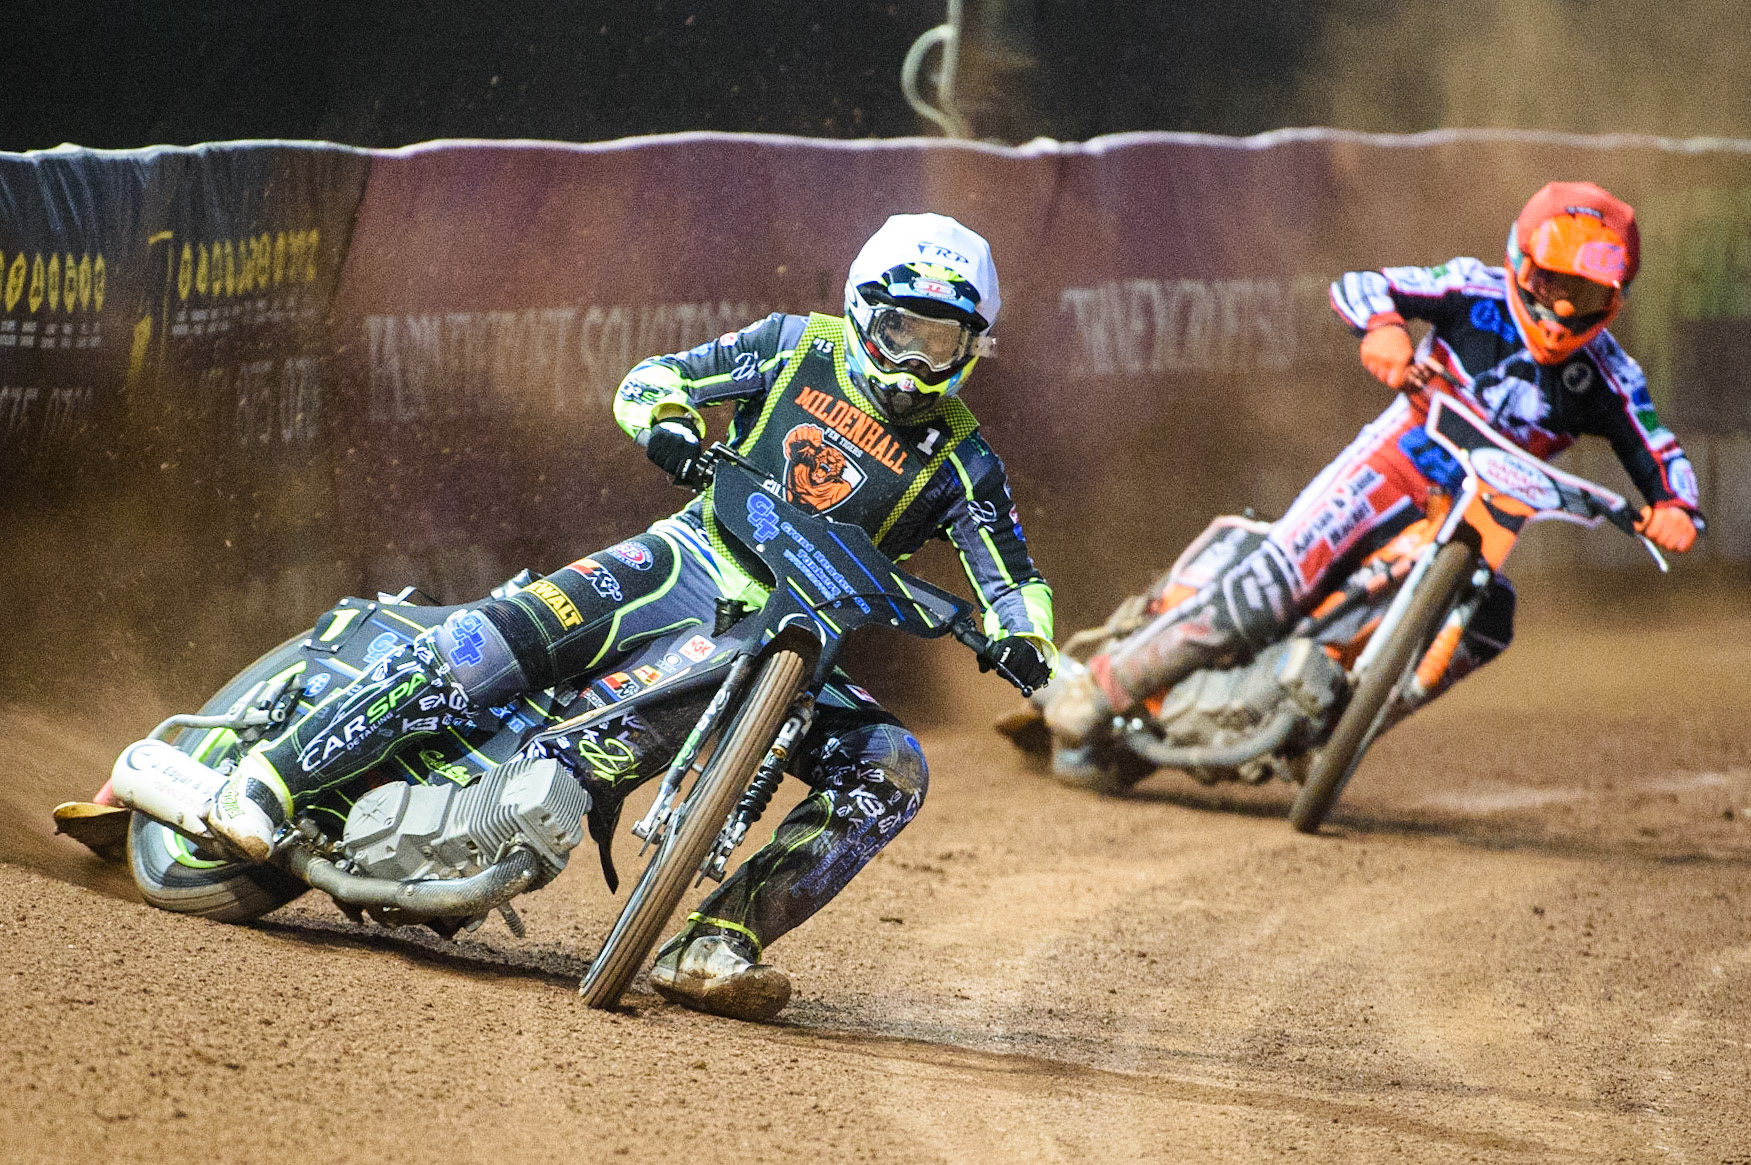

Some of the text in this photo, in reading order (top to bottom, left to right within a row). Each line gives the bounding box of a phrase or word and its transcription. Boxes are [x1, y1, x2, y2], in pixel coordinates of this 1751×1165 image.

[794, 386, 908, 476] MILDENHALL
[825, 427, 864, 459] FEN TIGERS
[917, 427, 940, 456] 1
[319, 608, 361, 642] 1
[690, 639, 712, 657] NGK
[345, 711, 395, 751] DETAILING
[162, 765, 193, 786] Edgar
